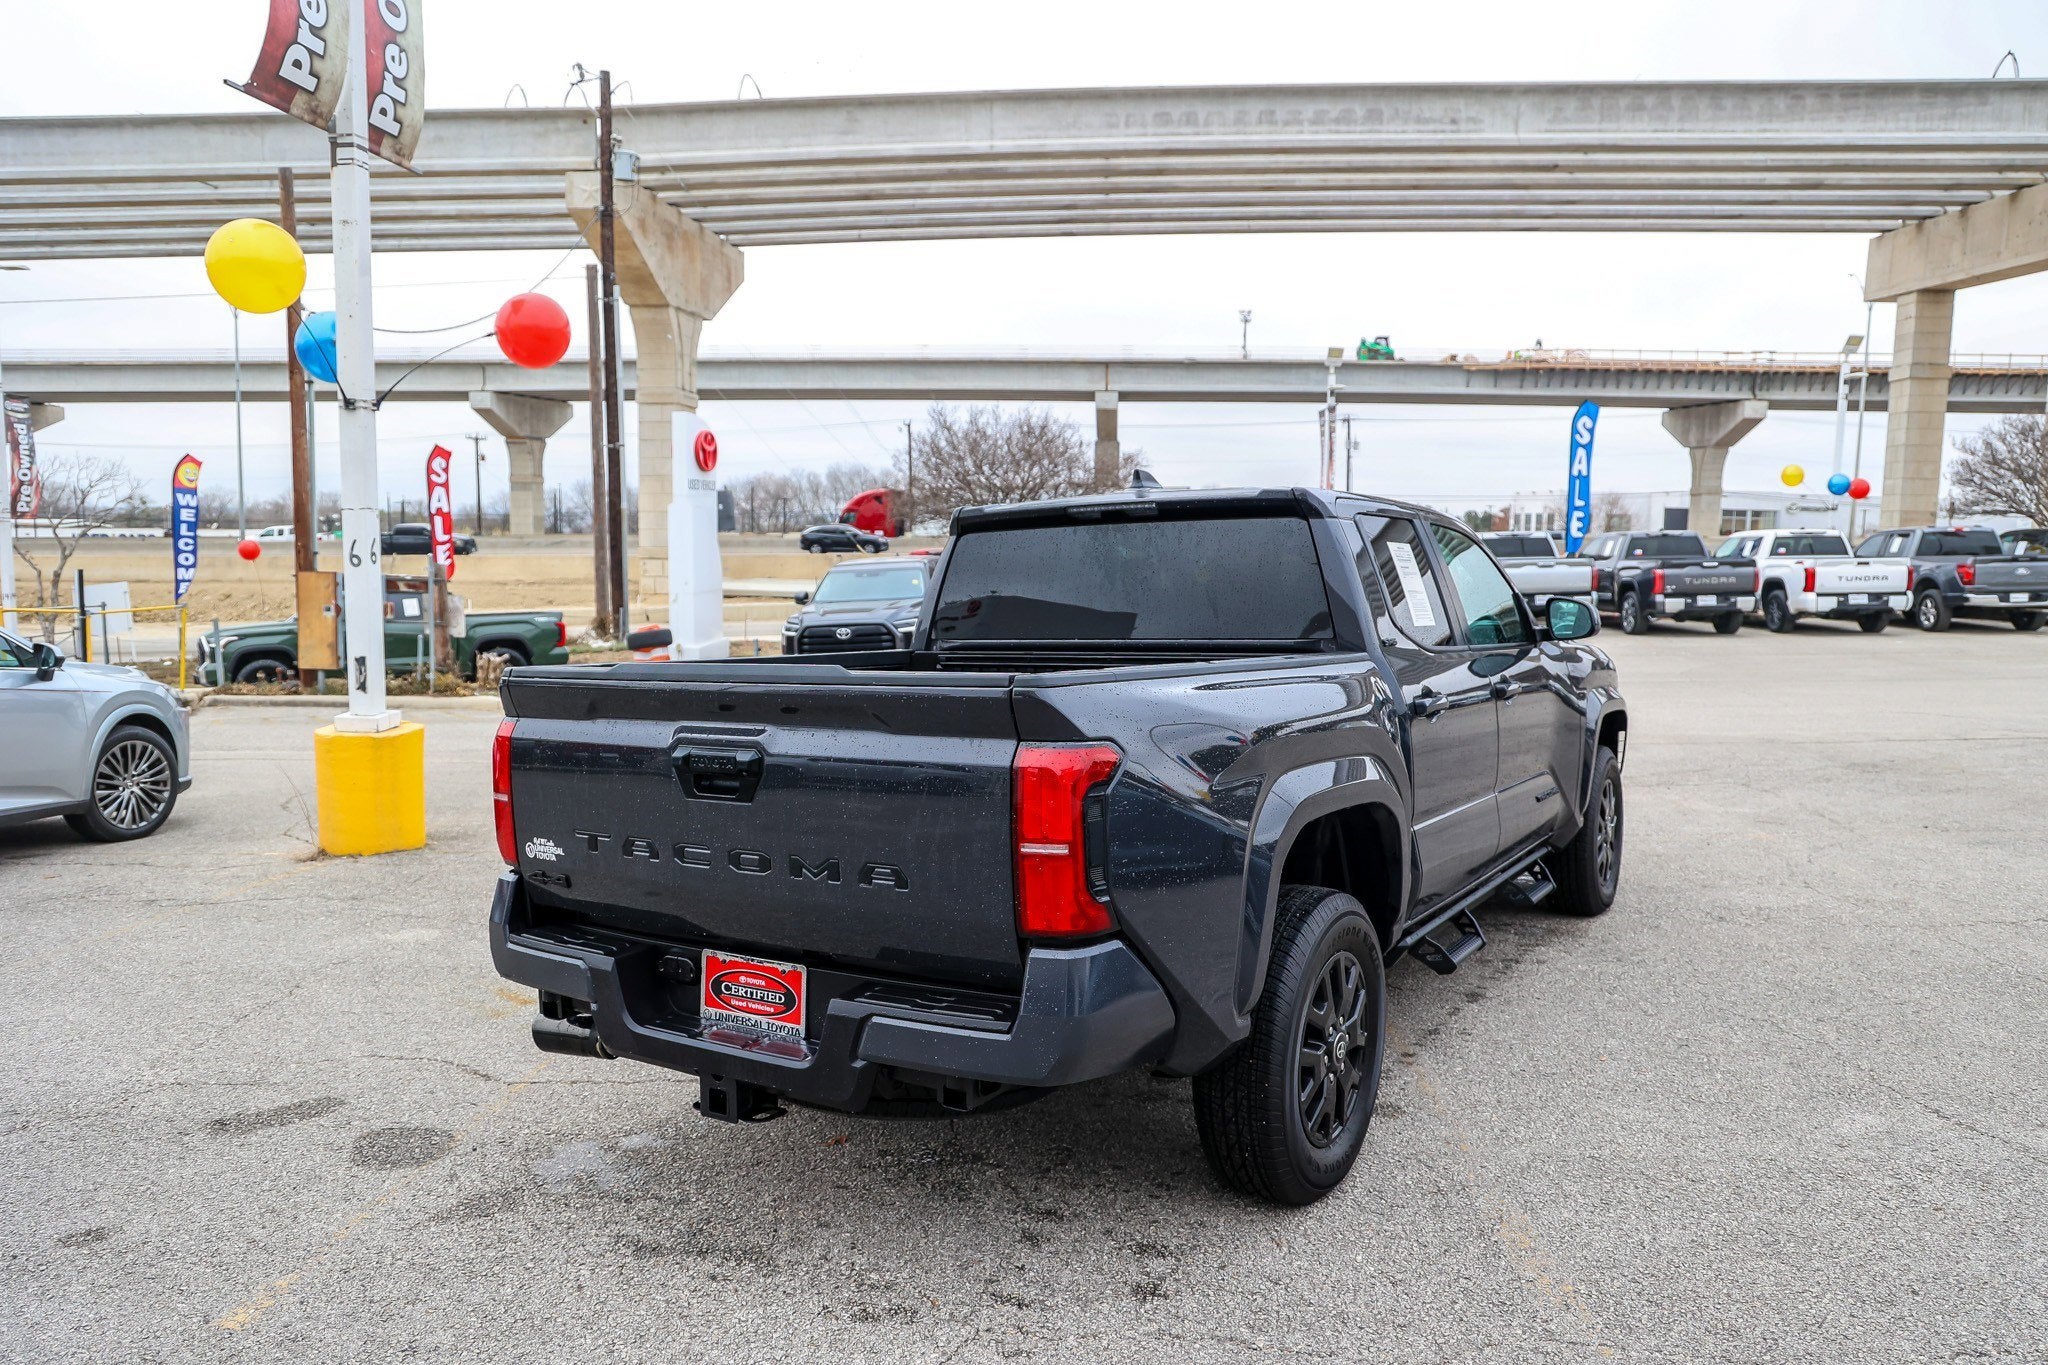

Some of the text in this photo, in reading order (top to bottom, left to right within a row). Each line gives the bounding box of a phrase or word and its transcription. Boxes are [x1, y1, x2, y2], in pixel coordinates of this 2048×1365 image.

[368, 43, 408, 137] Pre
[1569, 415, 1594, 539] SALE
[430, 455, 452, 566] SALE
[1684, 576, 1737, 585] TUNDRA
[1838, 574, 1889, 582] TUNDRA
[691, 757, 734, 770] TOYOTA
[534, 844, 565, 856] UNIVERSAL
[535, 852, 557, 861] TOYOTA
[574, 829, 909, 891] TACOMA
[746, 977, 766, 986] TOYOTA
[730, 999, 775, 1012] Used Vehicles
[714, 1011, 765, 1029] UNIVERSAL
[766, 1019, 801, 1037] TOYOTA
